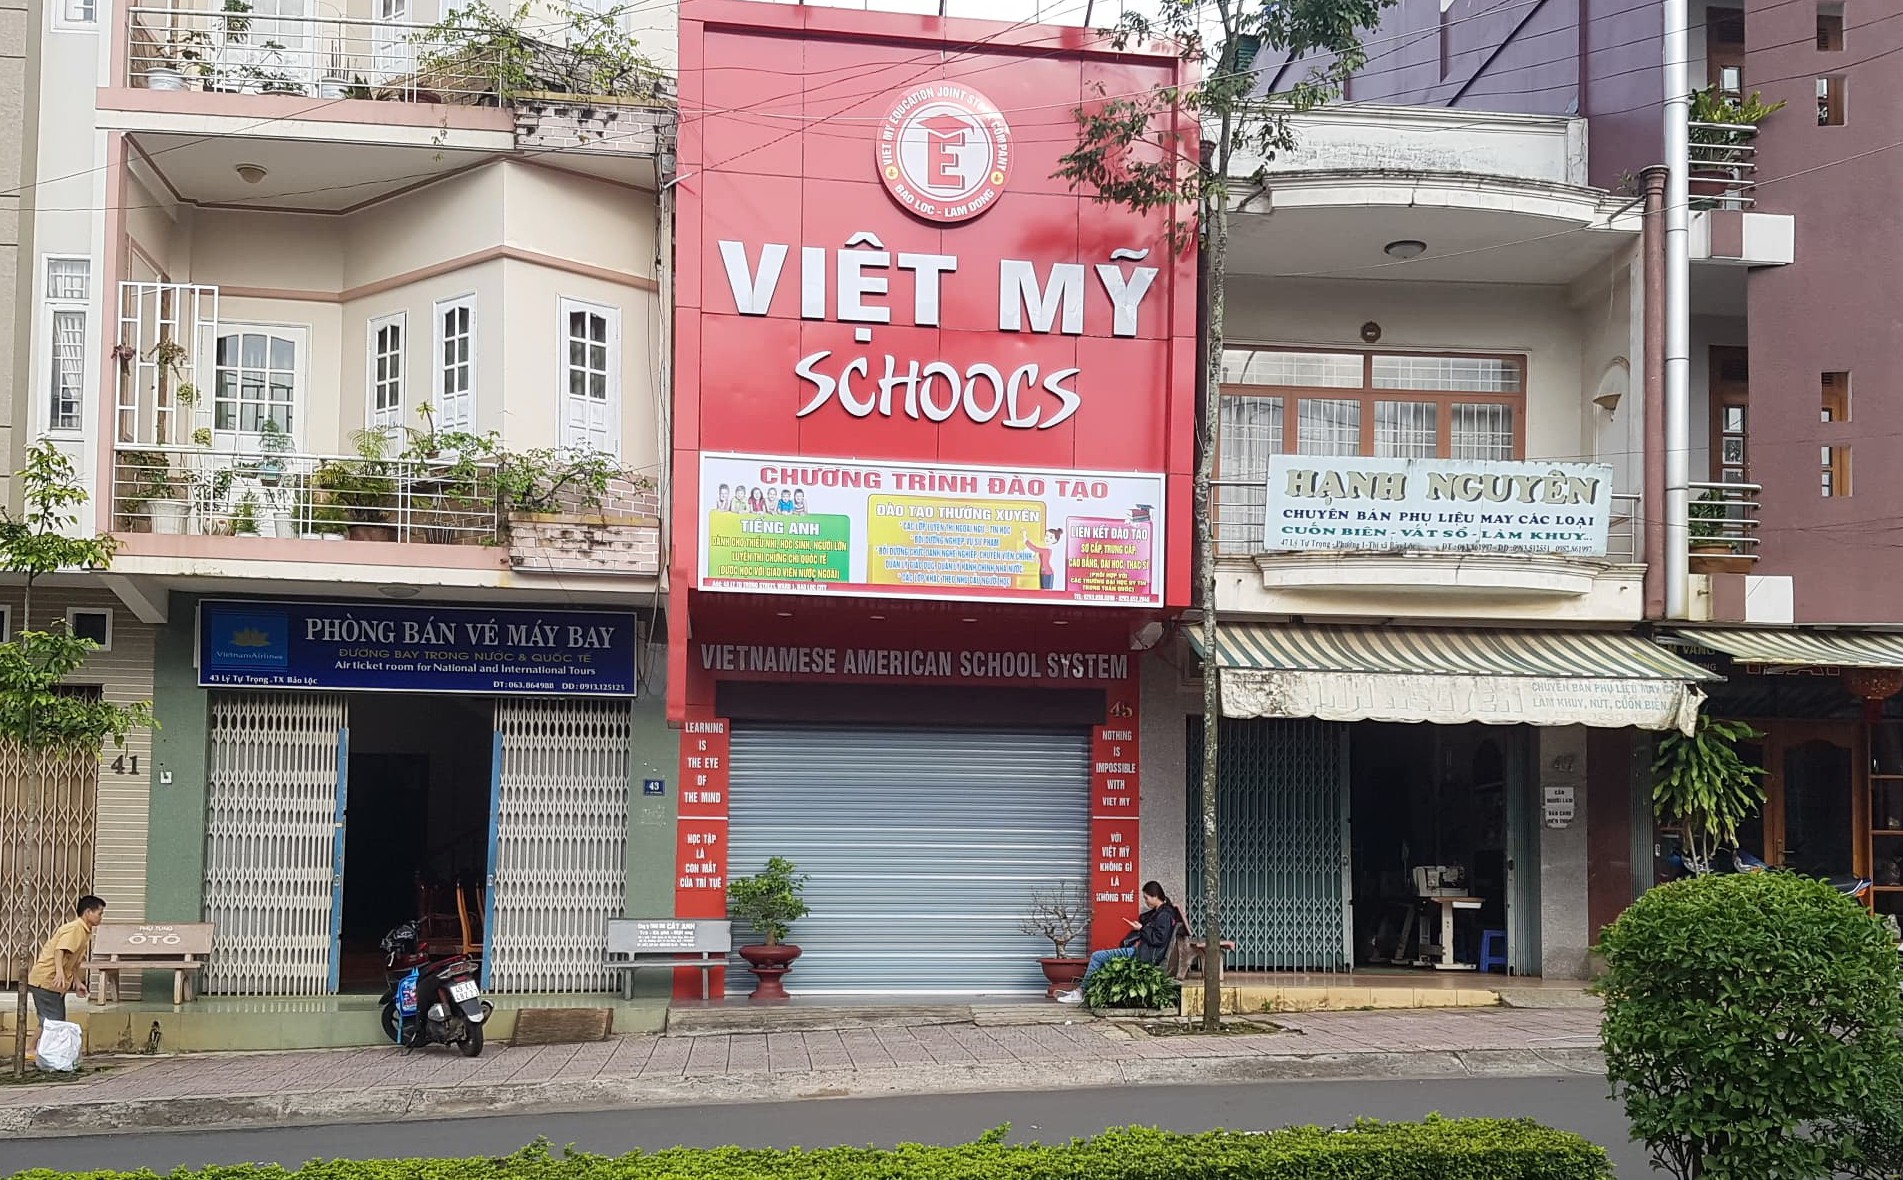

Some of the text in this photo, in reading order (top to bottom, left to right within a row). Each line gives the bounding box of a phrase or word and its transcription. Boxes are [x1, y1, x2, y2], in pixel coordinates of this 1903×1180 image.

[882, 86, 1008, 171] VIET MY EDUCATION JOINT COMPANY
[894, 184, 995, 218] BAO LOC LAM DONG
[717, 230, 1160, 342] VIỆT MỸ
[795, 349, 1083, 430] SCHOOLS
[760, 467, 1109, 502] CHƯƠNG TRÌNH ĐÀO TẠO
[1284, 469, 1600, 505] HẠNH NGUYÊN
[908, 505, 934, 520] TẠO
[995, 508, 1040, 522] XUYÊN
[1283, 508, 1594, 529] CHUYÊN BÁN PHỤ LIỆU MAY CÁC LOẠI
[740, 518, 820, 535] TIẾNG ANH
[1281, 521, 1336, 536] CUỐN
[1341, 525, 1387, 537] BIÊN
[1481, 528, 1522, 540] LÀM
[305, 613, 615, 649] PHÒNG BÁN VÉ MÁY BAY
[394, 650, 419, 659] BAY
[424, 651, 469, 660] TRONG
[518, 653, 527, 661] &
[700, 643, 1128, 679] VIETNAMESE AMERICAN SCHOOL SYSTEM
[334, 660, 596, 675] Air ticket room for National and International Tours
[246, 674, 269, 685] Trọng
[1110, 700, 1133, 718] 45
[685, 722, 724, 734] LEARNING
[1103, 730, 1132, 741] NOTHING
[699, 740, 707, 751] IS
[1113, 746, 1120, 757] IS
[111, 755, 140, 775] 41
[688, 757, 719, 769] THE EYE
[1096, 762, 1136, 774] IMPOSSIBLE
[649, 781, 660, 791] 43
[697, 775, 707, 786] OF
[1107, 779, 1125, 790] WITH
[684, 792, 721, 803] THE MIND
[1102, 797, 1131, 807] VIET MY
[687, 832, 717, 846] HỌC TẬP
[1110, 832, 1122, 843] VỚI
[695, 846, 705, 859] LÀ
[1102, 845, 1130, 858] VIỆT MỸ
[685, 859, 717, 874] CON MẮT
[1100, 861, 1132, 872] KHÔNG GÌ
[680, 875, 693, 888] CỦA
[696, 876, 707, 888] TRÍ
[1110, 875, 1120, 887] LÀ
[1096, 889, 1134, 903] KHÔNG THỂ
[128, 933, 181, 945] ÔTÔ
